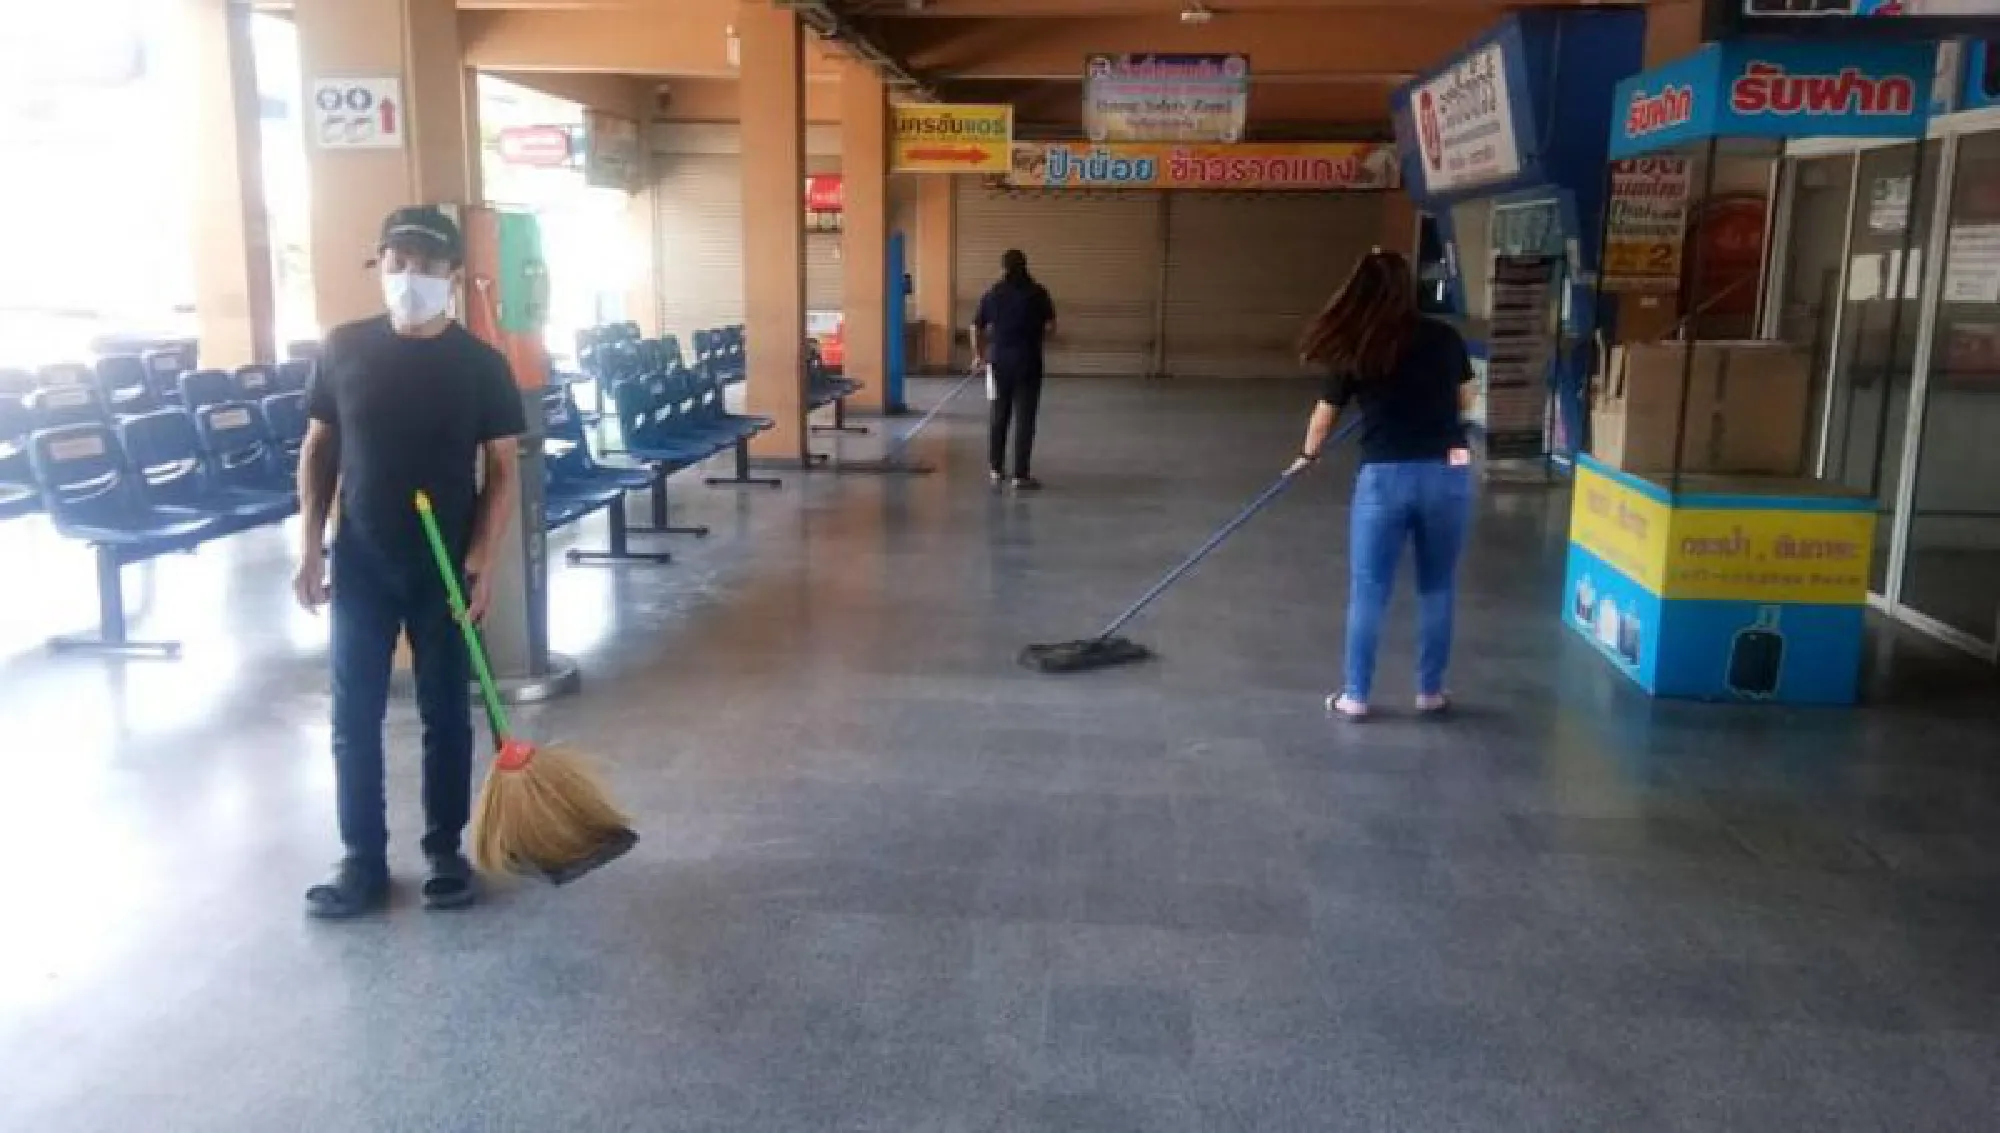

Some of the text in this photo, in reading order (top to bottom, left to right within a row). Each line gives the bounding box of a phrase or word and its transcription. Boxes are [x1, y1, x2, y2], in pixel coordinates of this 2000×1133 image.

[1624, 83, 1692, 137] รับฝาก
[1733, 60, 1914, 113] รับฝาก
[1170, 149, 1357, 182] ข้าวราดแกง
